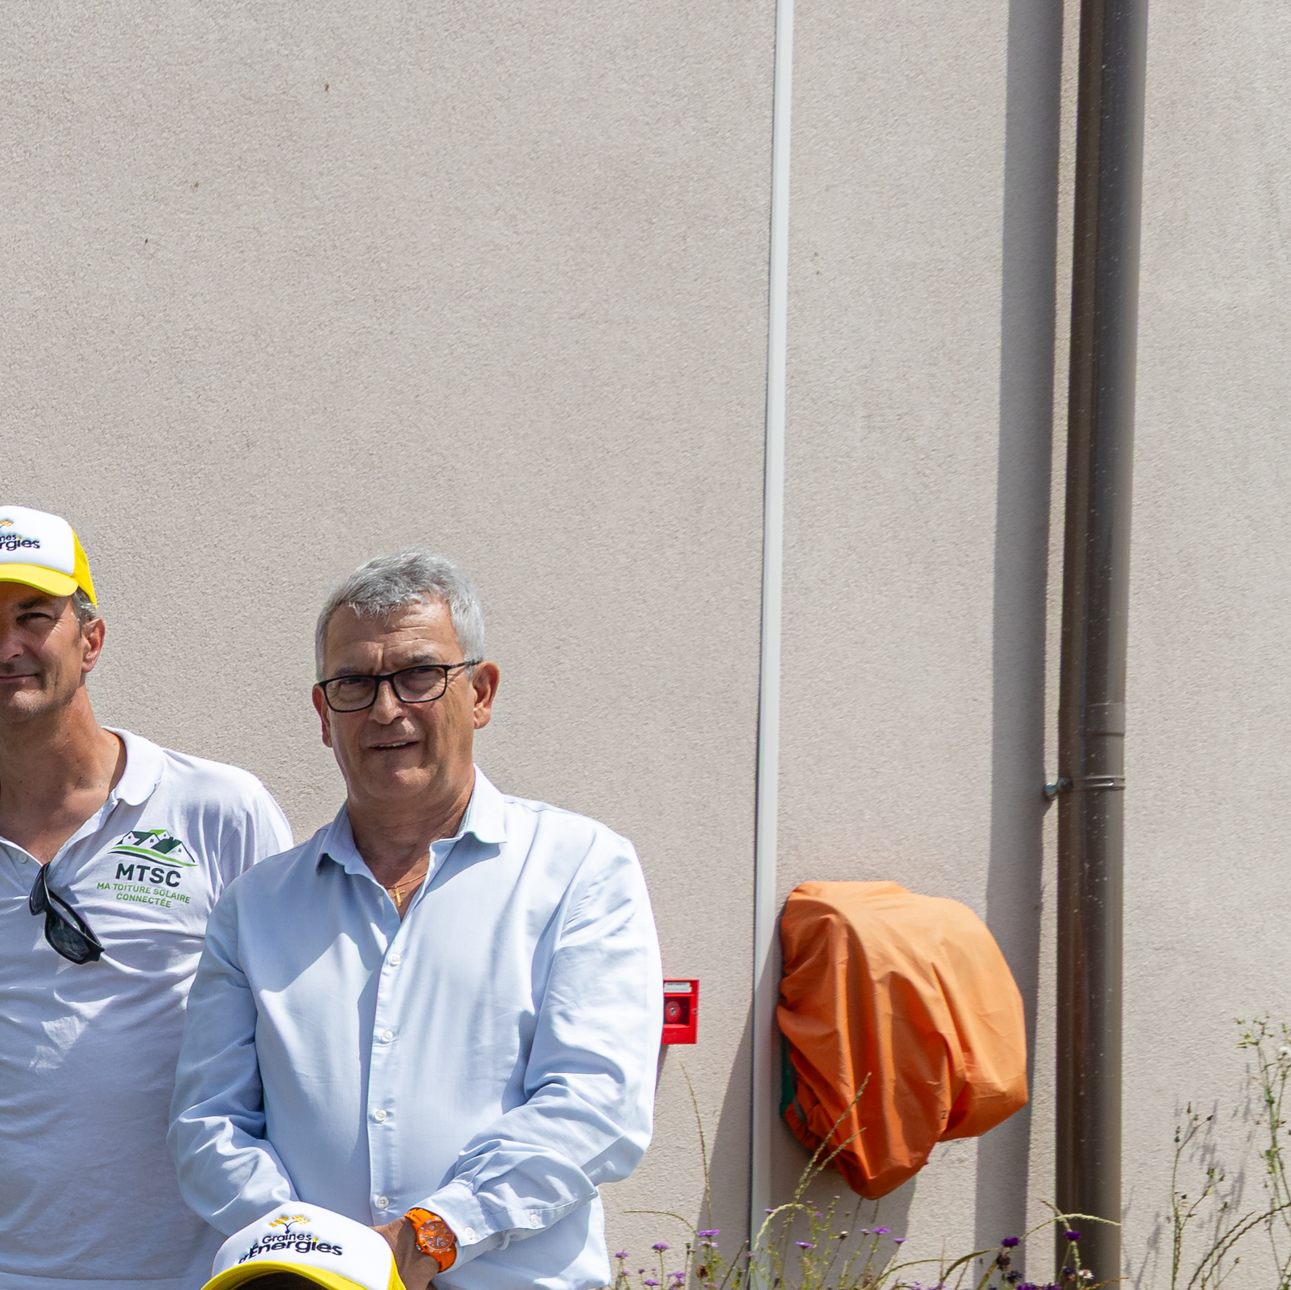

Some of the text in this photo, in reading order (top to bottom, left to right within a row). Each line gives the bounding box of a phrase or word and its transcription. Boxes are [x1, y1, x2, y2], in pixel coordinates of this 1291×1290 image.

[115, 863, 181, 887] MTSC
[96, 882, 191, 904] MA TOITURE SOLAIRE
[116, 893, 172, 908] CONNECTÉE
[262, 1232, 312, 1244] Graines
